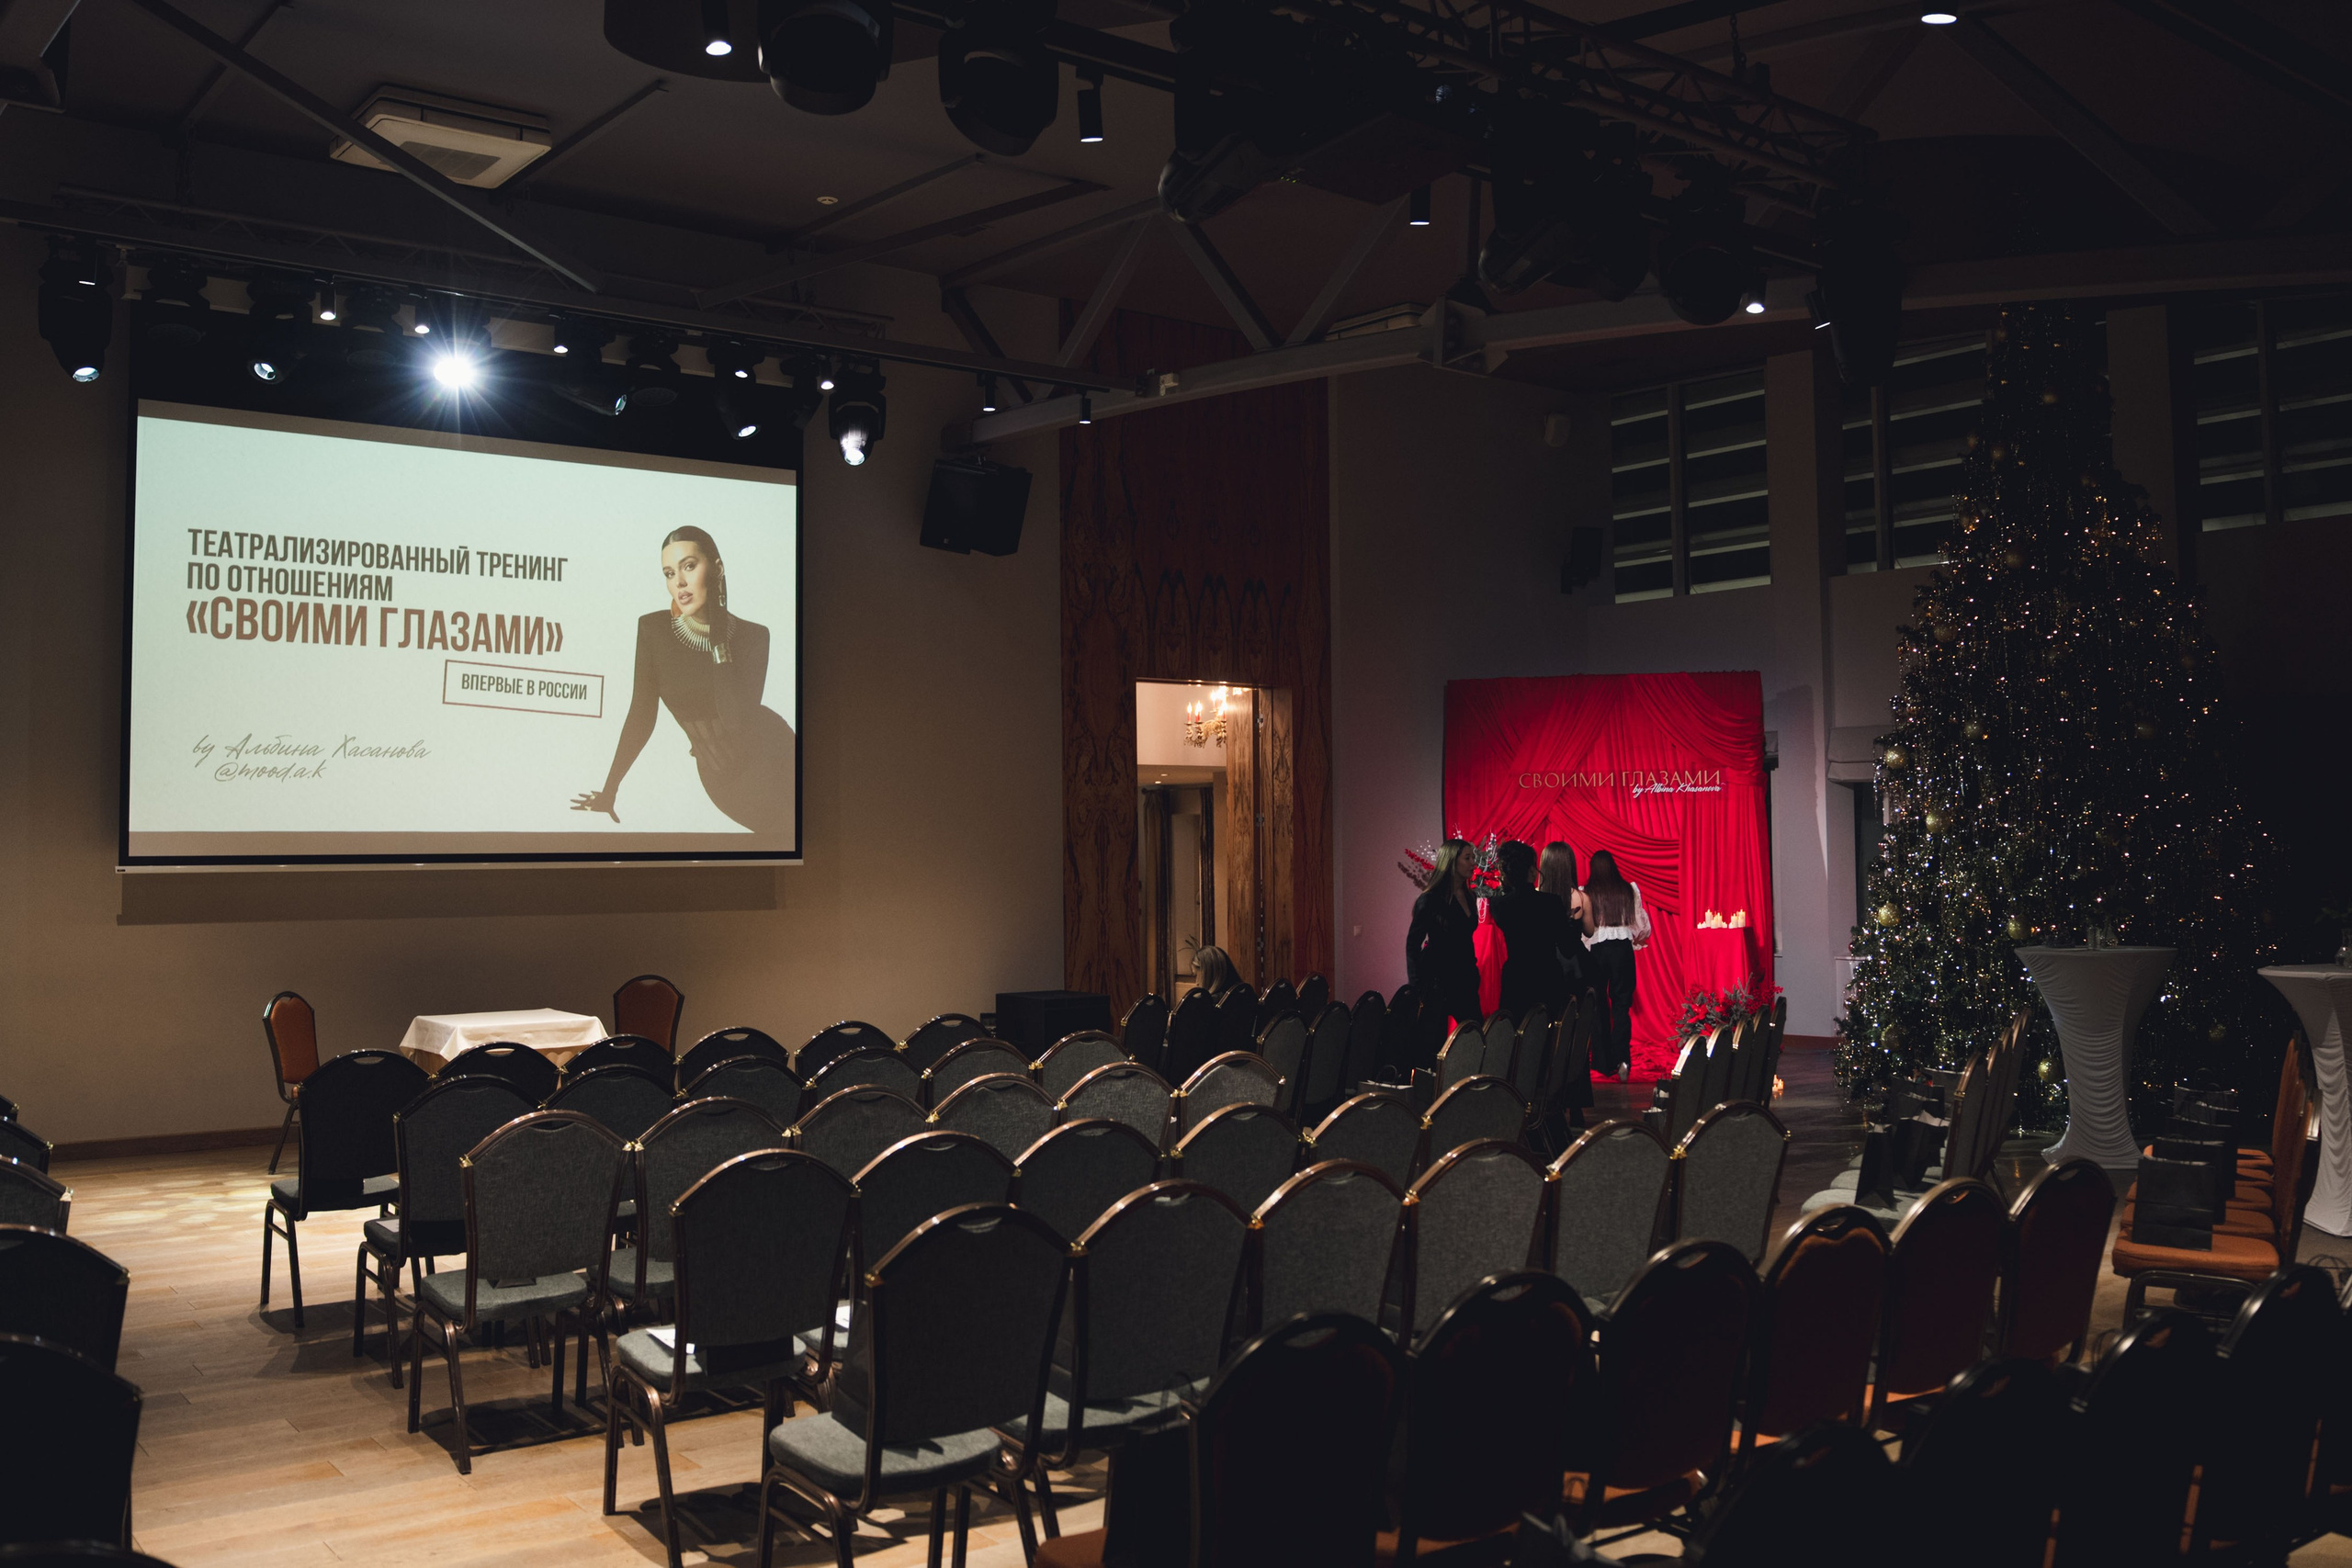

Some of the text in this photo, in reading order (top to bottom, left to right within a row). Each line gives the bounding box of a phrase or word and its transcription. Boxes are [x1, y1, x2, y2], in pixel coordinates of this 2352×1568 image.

[187, 528, 568, 581] ТЕАТРАЛИЗИРОВАННЫЙ ТРЕНИНГ
[187, 561, 393, 602] ПО ОТНОШЕНИЯМ
[186, 595, 564, 656] «СВОИМИ ГЛАЗАМИ»
[461, 672, 588, 701] ВПЕРВЫЕ В РОССИИ
[192, 732, 432, 768] by Альбина Хасанова
[1519, 770, 1720, 789] СВОИМИ ГЛАЗАМИ
[1632, 782, 1722, 798] by Albina Khasanova
